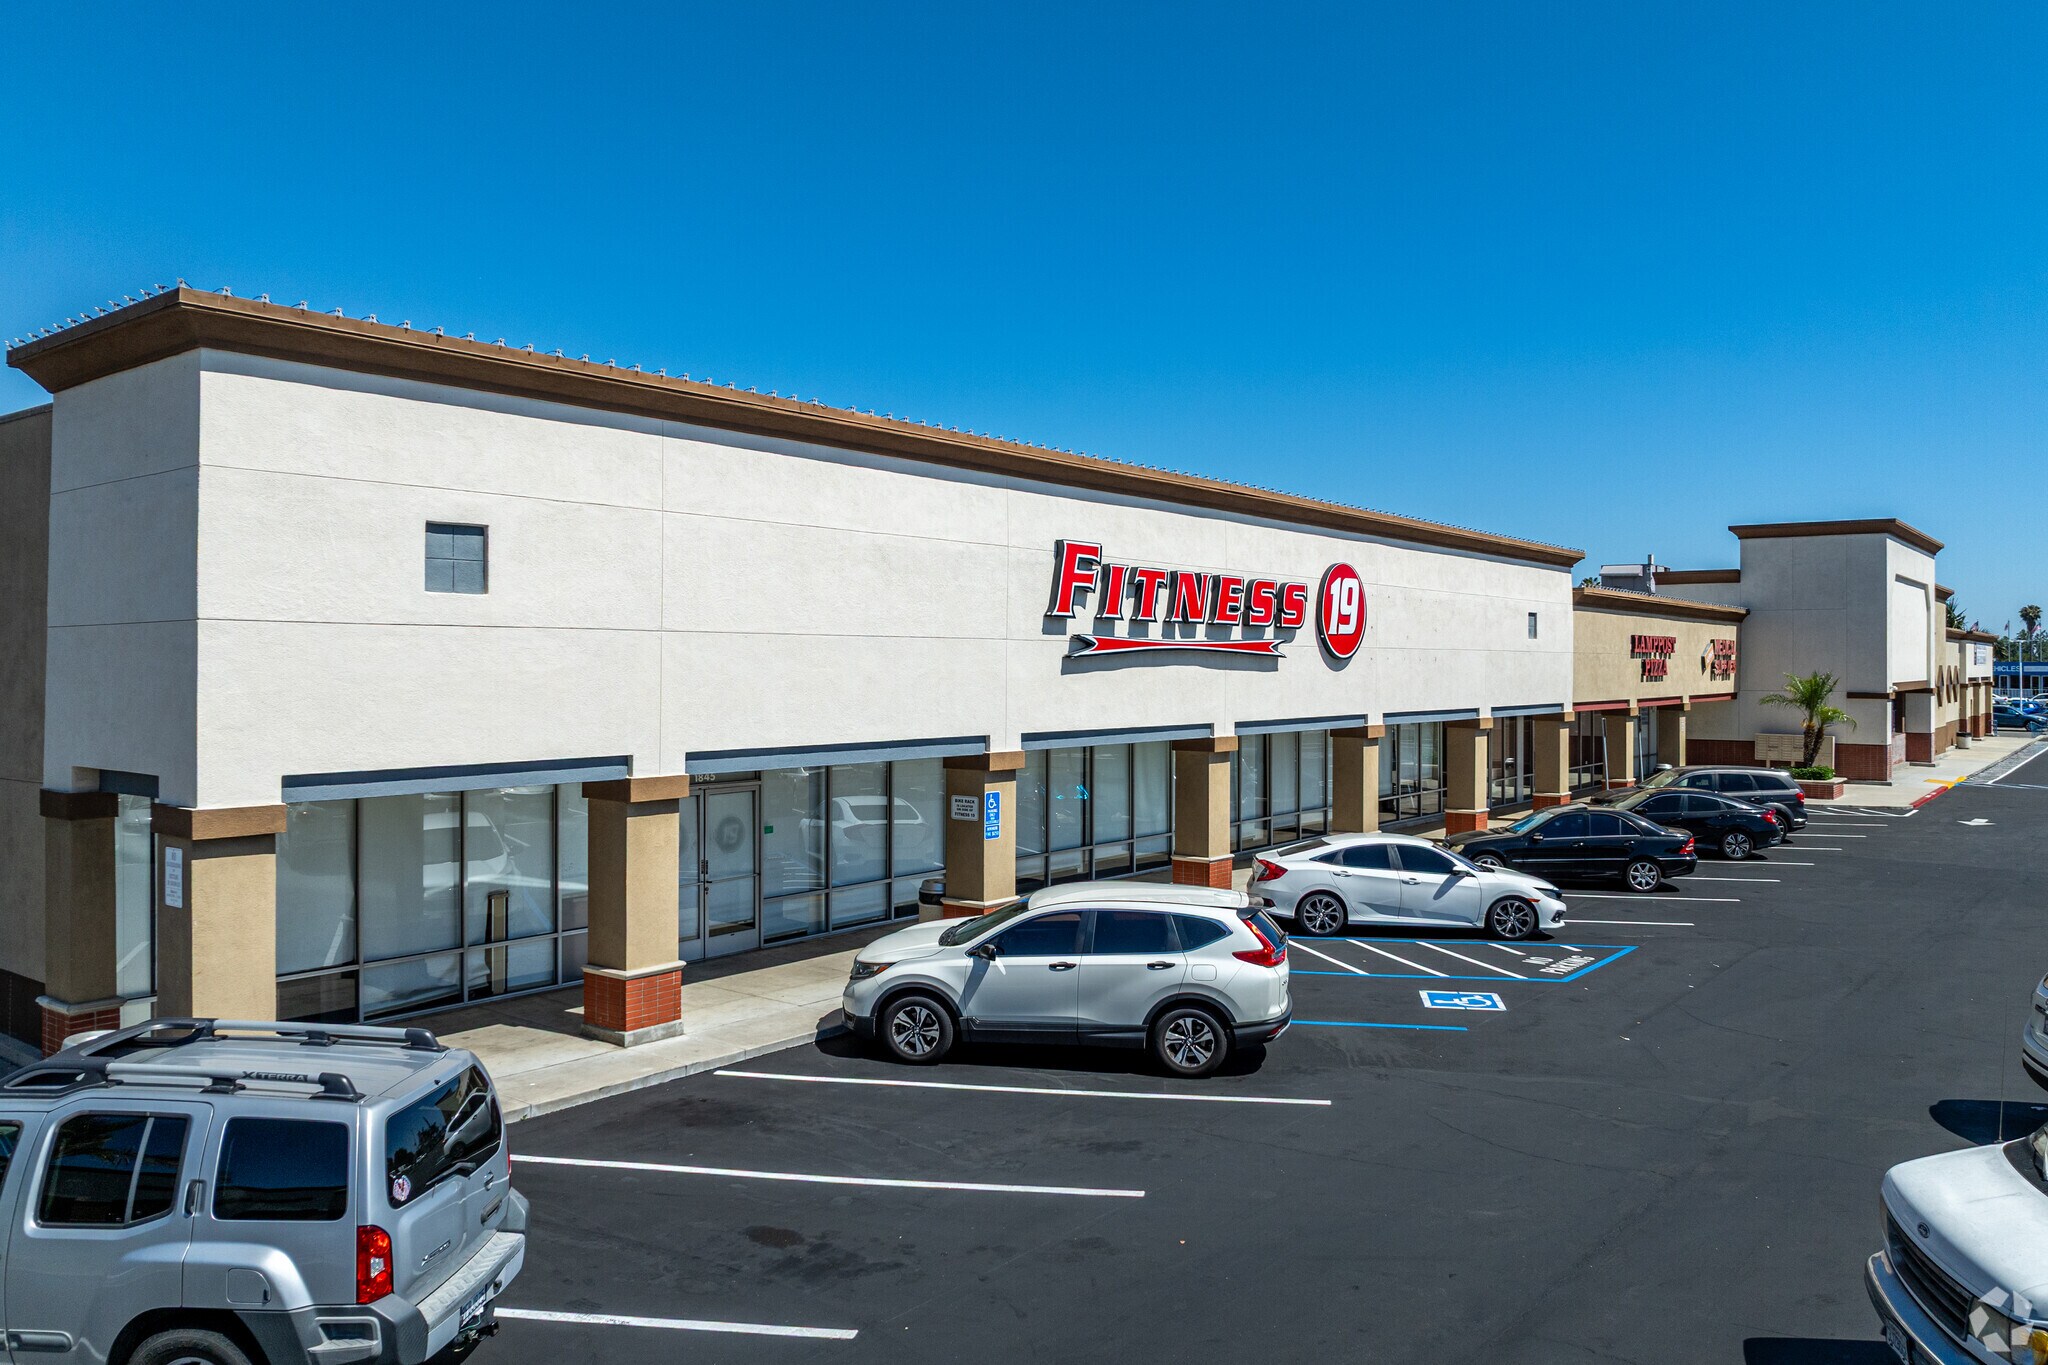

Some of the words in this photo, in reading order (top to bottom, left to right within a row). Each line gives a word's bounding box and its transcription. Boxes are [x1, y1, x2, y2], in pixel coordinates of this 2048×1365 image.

[1047, 539, 1309, 629] FITNESS
[1328, 576, 1360, 636] 19
[1634, 635, 1676, 653] LAMPPOST
[1645, 659, 1668, 676] PIZZA
[695, 775, 716, 783] 1845
[242, 1070, 308, 1083] XTERRA
